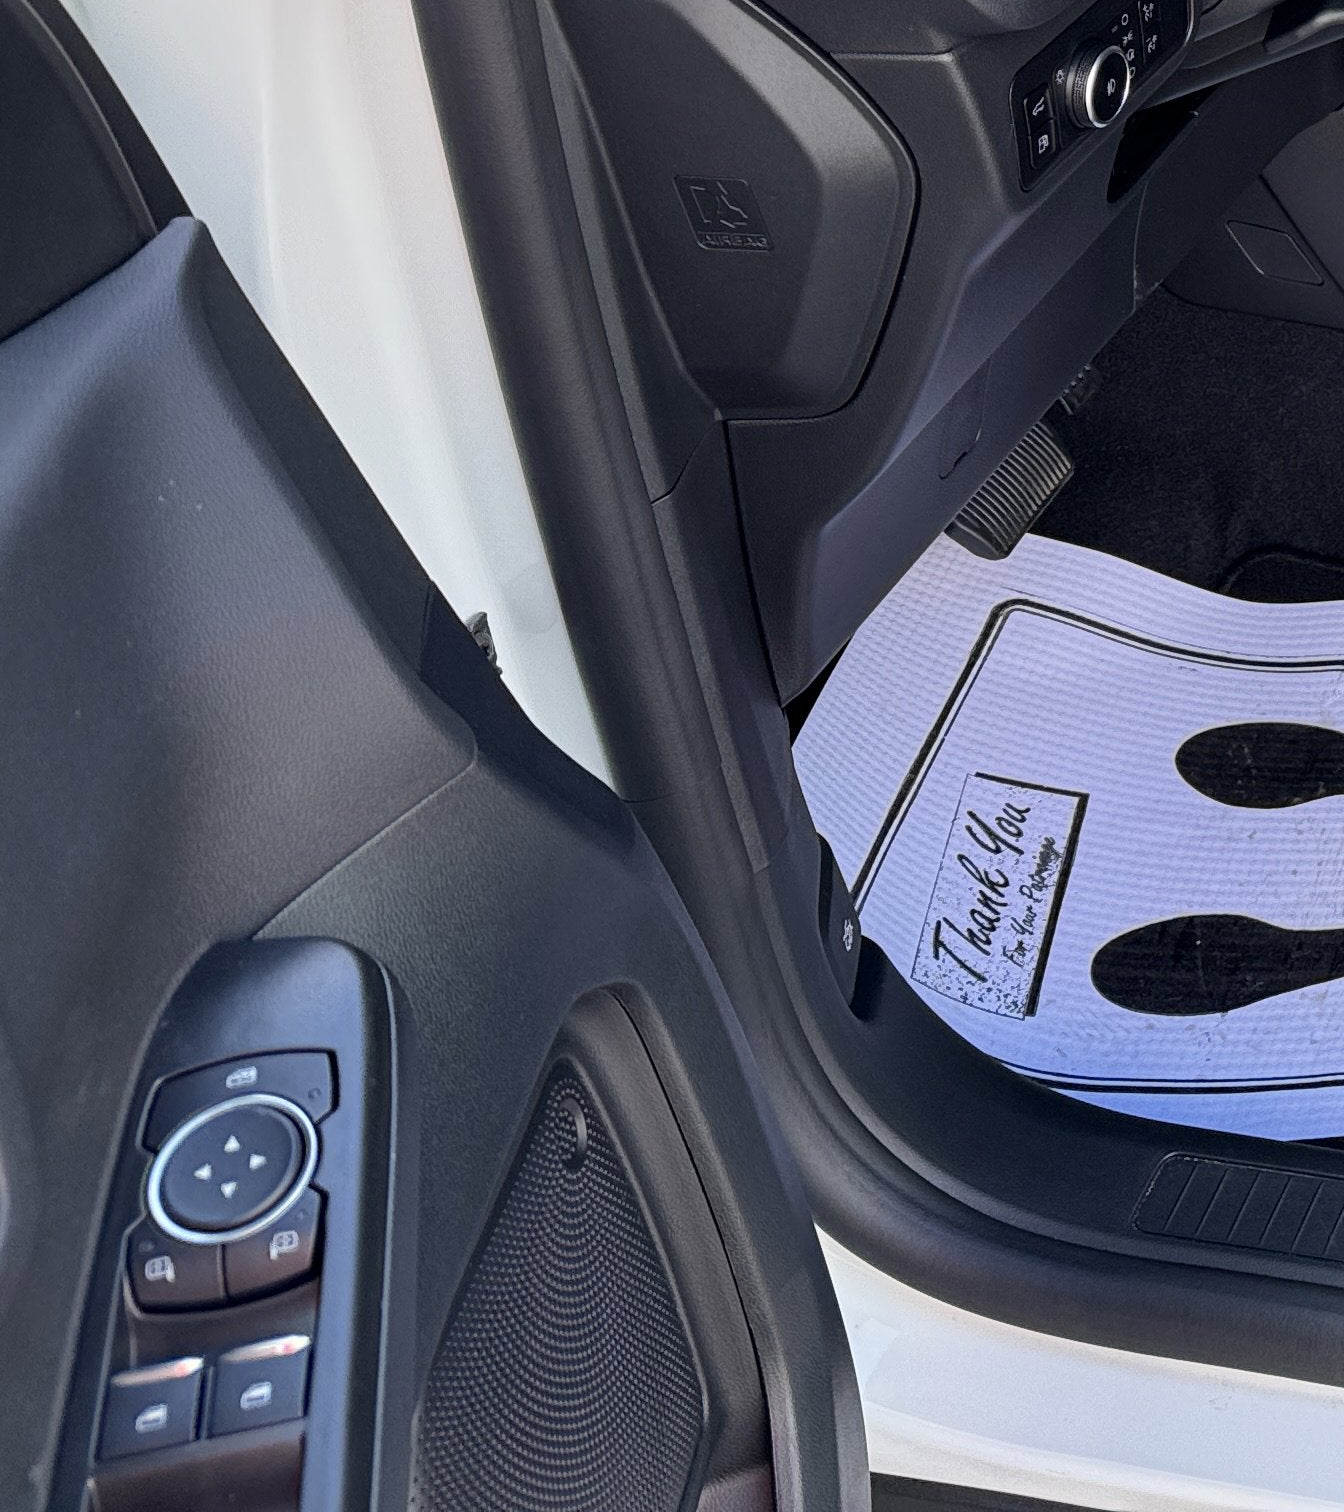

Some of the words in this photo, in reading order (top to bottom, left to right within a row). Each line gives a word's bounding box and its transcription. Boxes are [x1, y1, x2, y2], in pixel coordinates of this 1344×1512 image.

[703, 234, 768, 248] AIRBAG
[964, 802, 1031, 856] You
[932, 853, 1010, 983] Thank
[1009, 904, 1037, 936] Your
[1002, 939, 1028, 968] For
